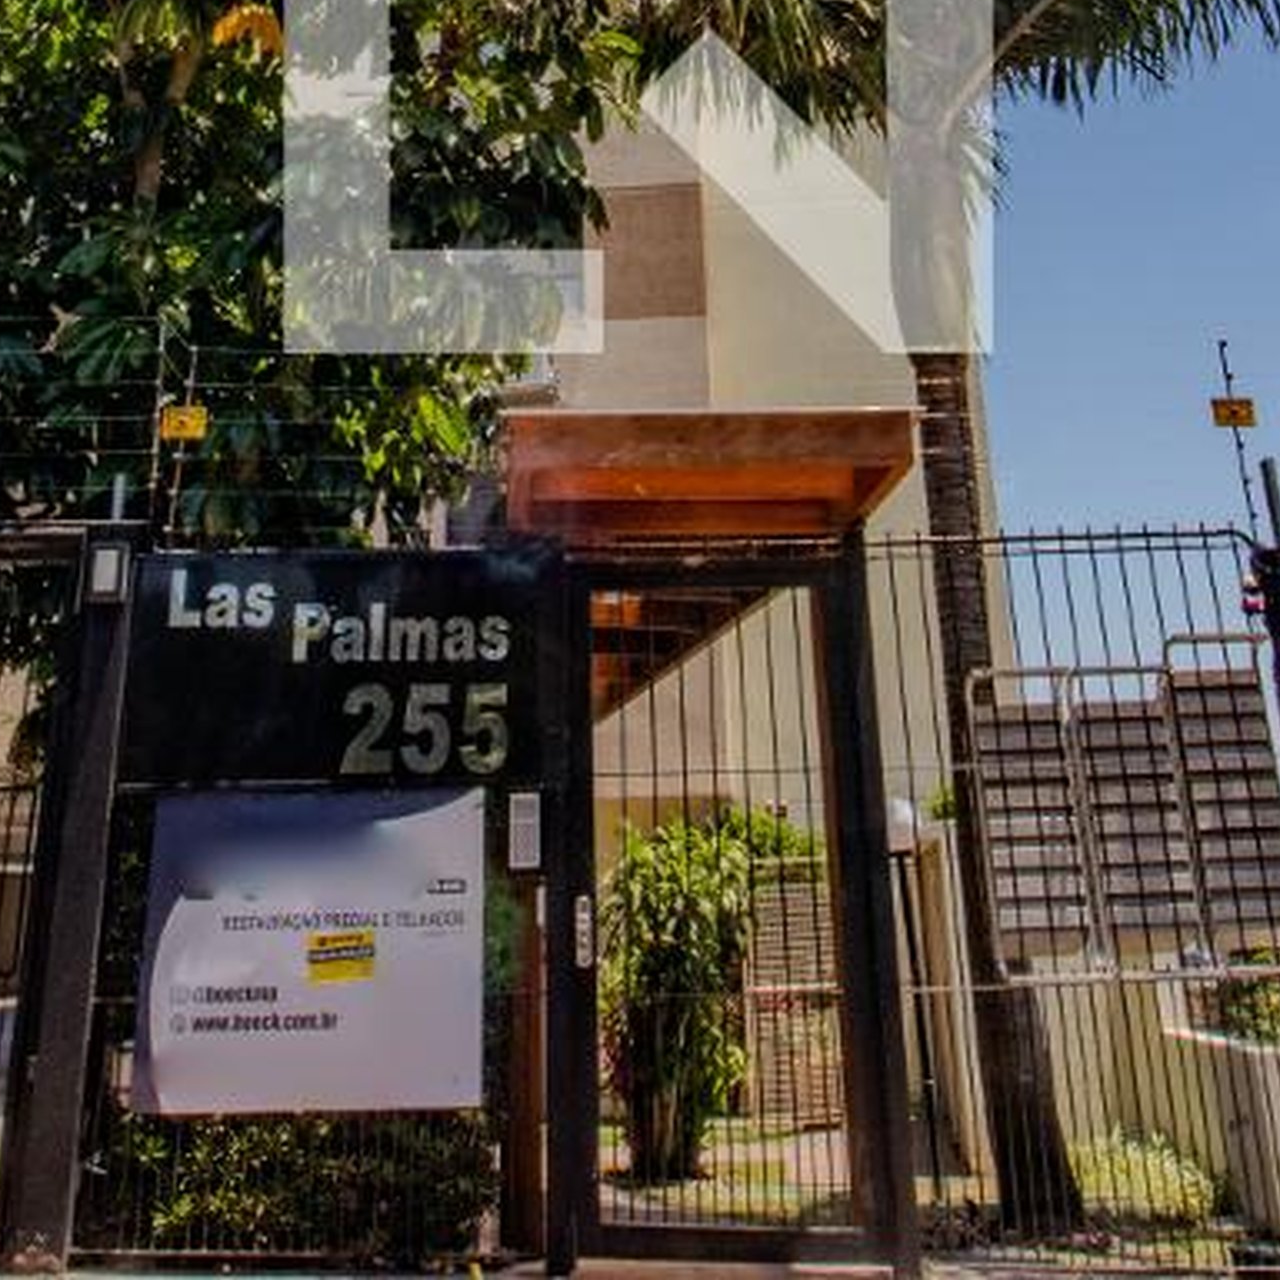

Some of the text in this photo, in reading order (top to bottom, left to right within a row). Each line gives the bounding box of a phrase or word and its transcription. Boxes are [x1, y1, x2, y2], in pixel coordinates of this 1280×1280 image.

[168, 569, 511, 663] Las Palmas
[340, 683, 508, 774] 255
